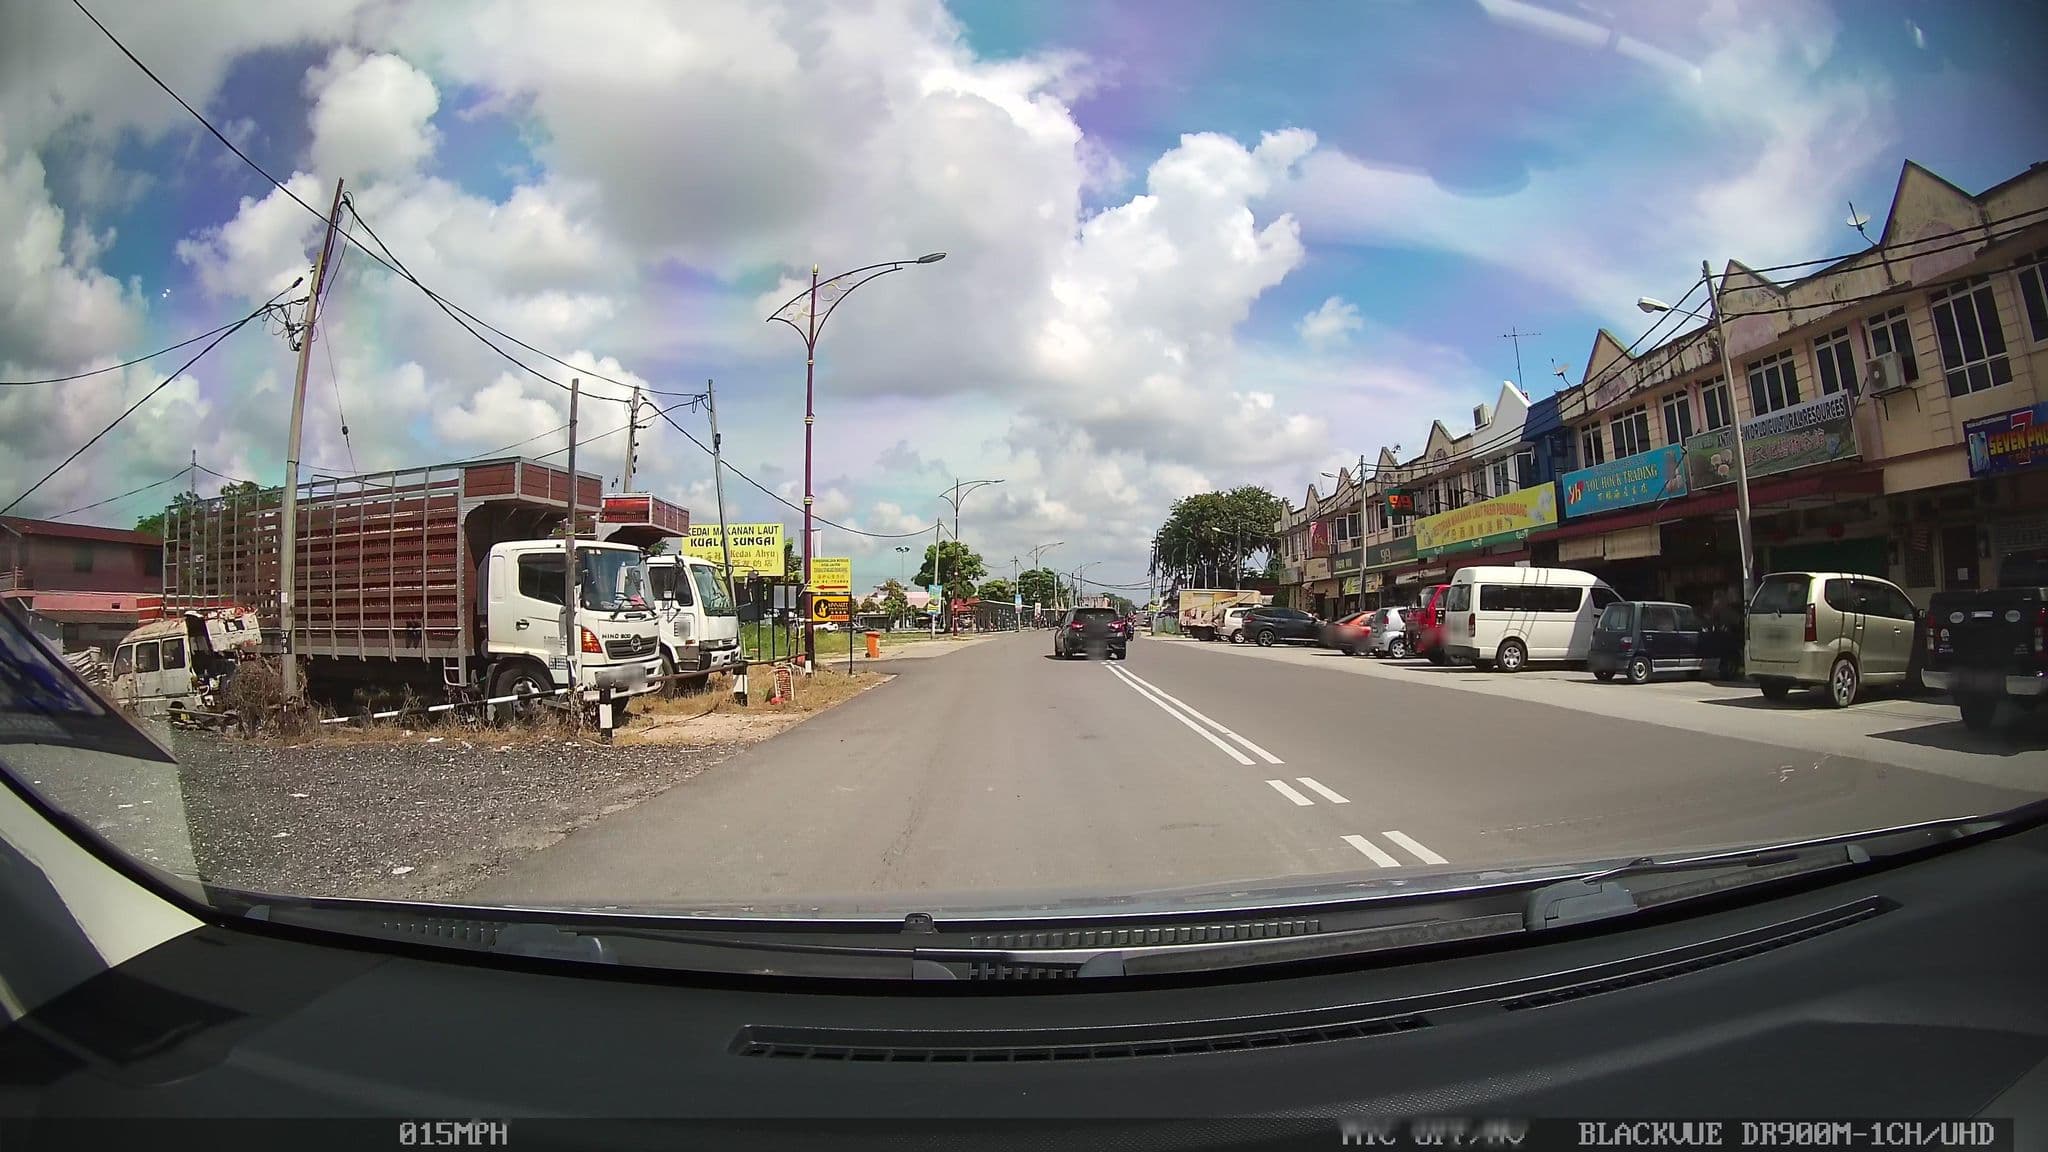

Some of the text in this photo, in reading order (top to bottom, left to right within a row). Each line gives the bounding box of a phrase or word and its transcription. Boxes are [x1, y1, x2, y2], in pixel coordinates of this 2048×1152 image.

[1744, 421, 1768, 441] WORLD
[1802, 397, 1846, 426] RESOURCES
[1989, 430, 2026, 455] SEVEN
[1623, 463, 1657, 484] TRADING
[757, 525, 779, 535] LAUT
[733, 536, 775, 546] SUNGAI
